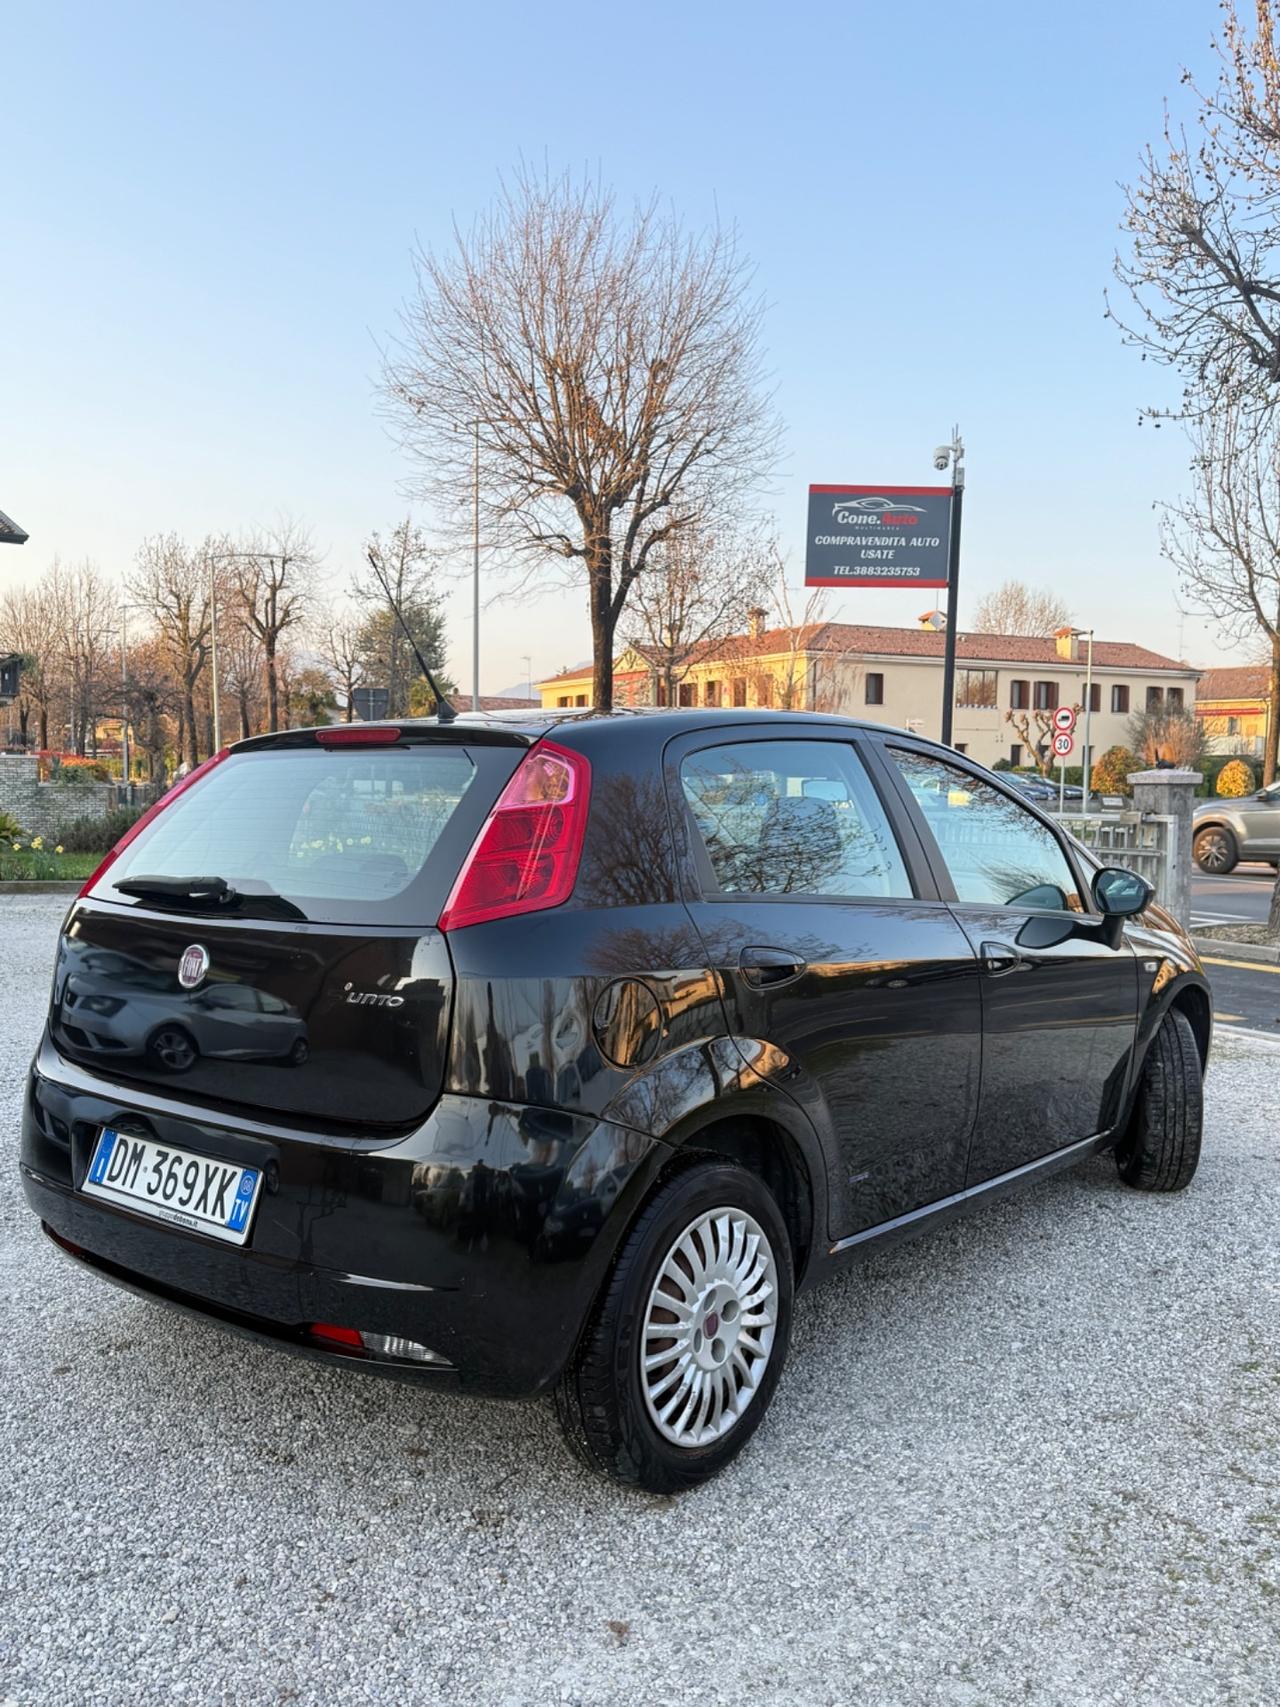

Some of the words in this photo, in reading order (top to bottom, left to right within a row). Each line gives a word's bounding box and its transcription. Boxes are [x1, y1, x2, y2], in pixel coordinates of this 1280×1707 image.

[814, 535, 906, 547] COMPRAVENDITA
[909, 537, 940, 547] AUTO
[860, 549, 896, 560] USATE
[1057, 738, 1069, 750] 30
[106, 1138, 147, 1190] DM
[146, 1149, 238, 1220] 369XK
[231, 1198, 250, 1223] TV
